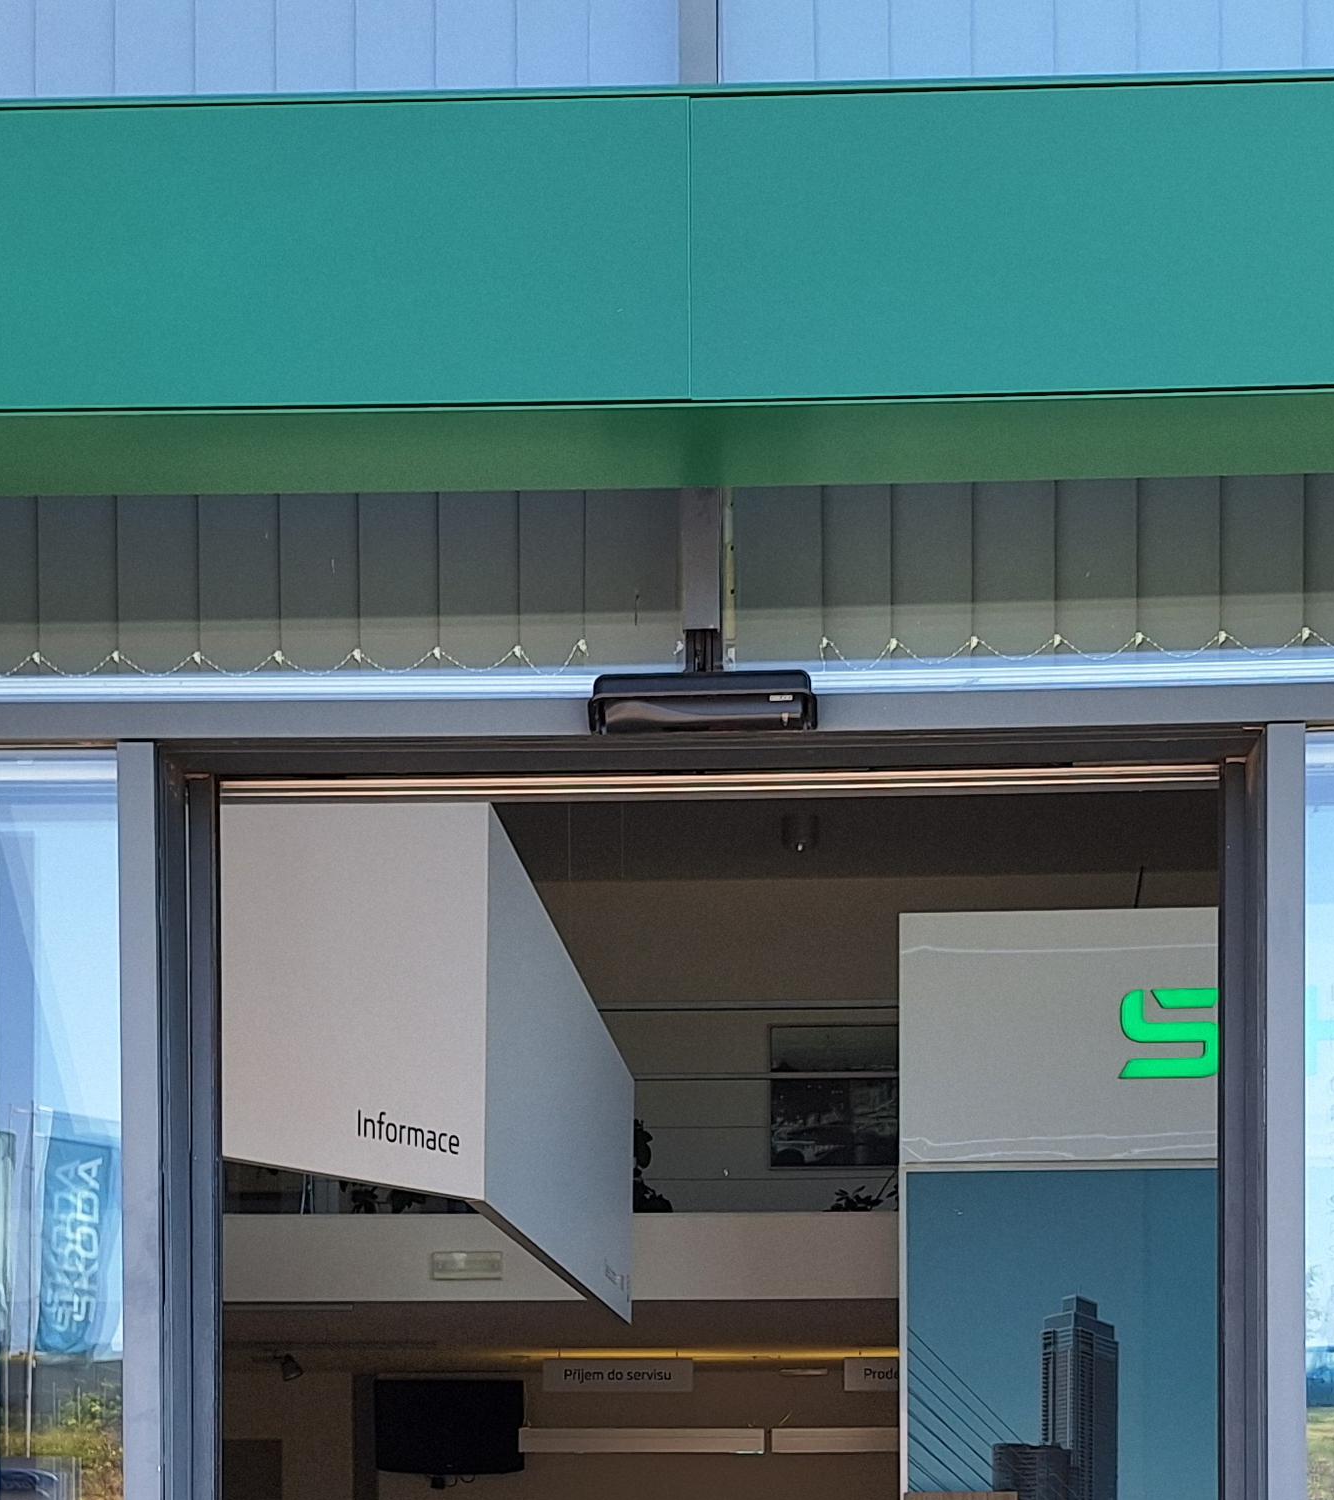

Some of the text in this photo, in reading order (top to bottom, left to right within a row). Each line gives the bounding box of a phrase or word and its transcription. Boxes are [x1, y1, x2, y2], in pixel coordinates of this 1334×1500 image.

[357, 1108, 460, 1155] Informace
[607, 1368, 624, 1381] do
[627, 1368, 672, 1381] servisu
